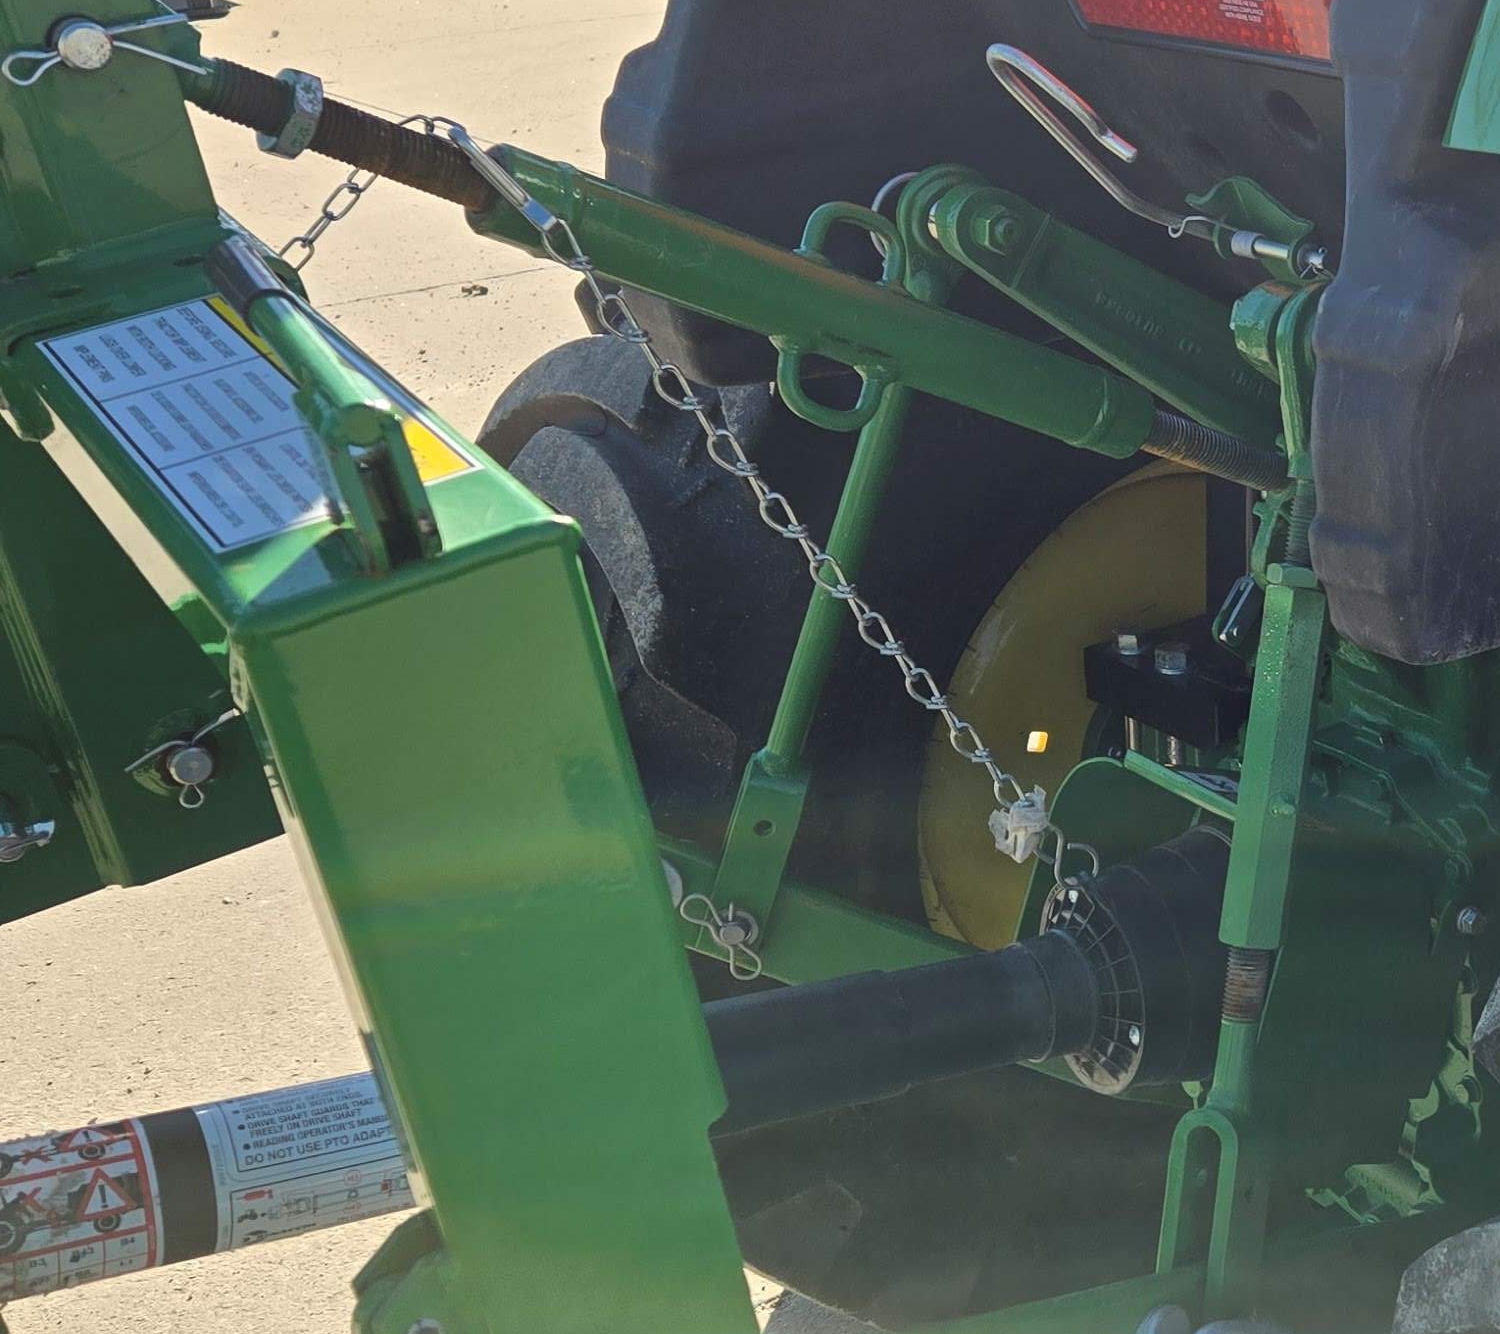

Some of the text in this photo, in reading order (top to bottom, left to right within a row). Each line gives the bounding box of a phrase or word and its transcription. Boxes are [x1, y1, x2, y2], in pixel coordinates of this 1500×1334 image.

[244, 1153, 264, 1166] DO
[267, 1146, 294, 1161] NOT
[296, 1140, 324, 1155] USE
[324, 1134, 350, 1149] PTO
